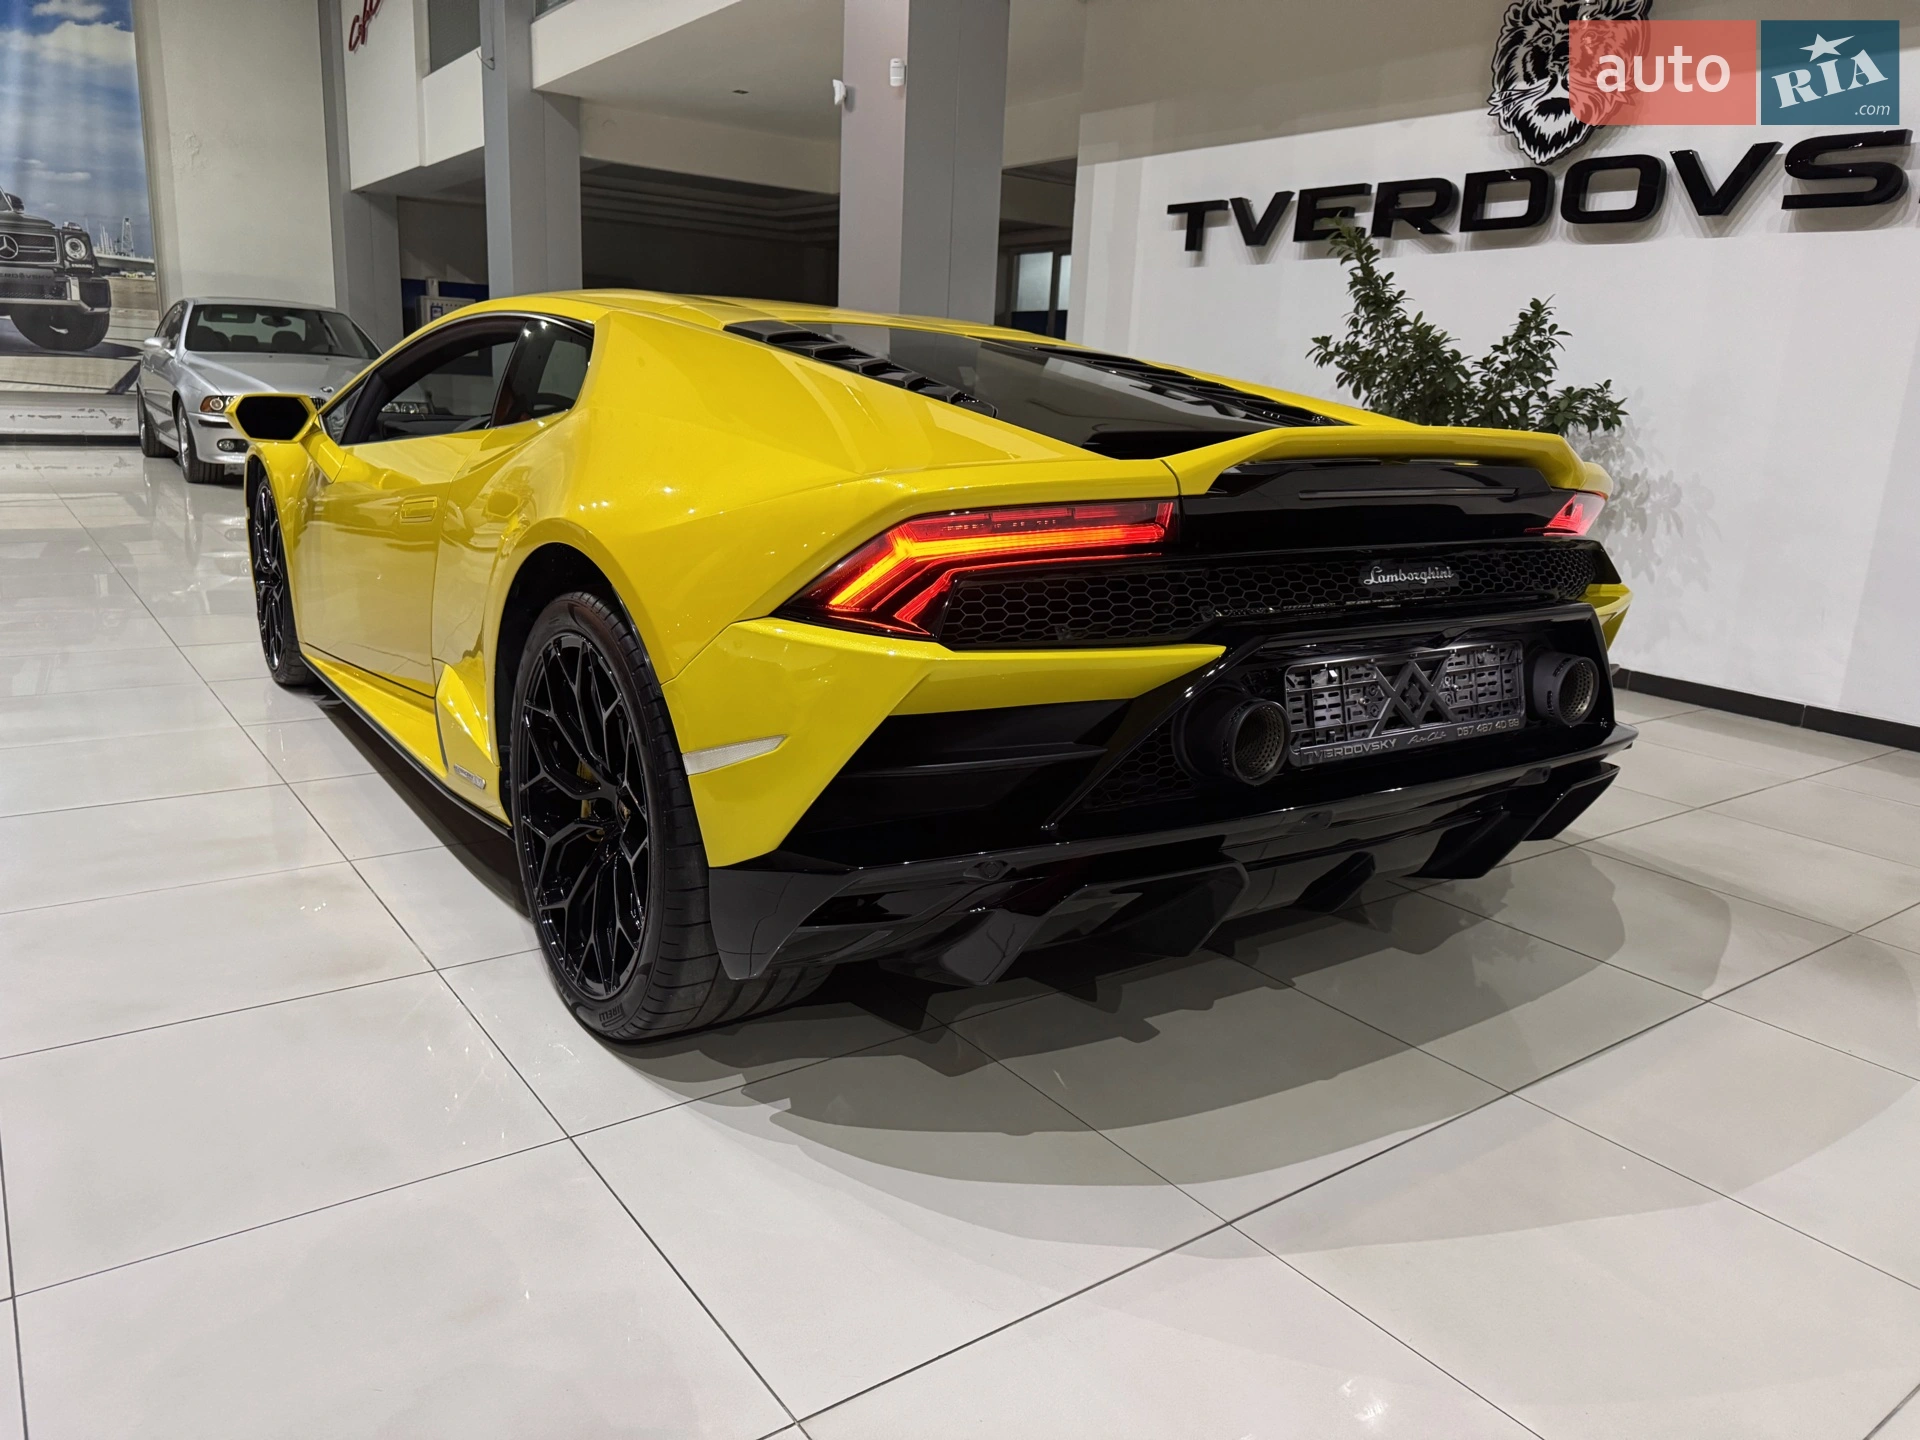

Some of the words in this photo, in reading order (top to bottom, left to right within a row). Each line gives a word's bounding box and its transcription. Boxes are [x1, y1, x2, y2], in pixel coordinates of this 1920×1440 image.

[1363, 566, 1454, 585] Lamborghini
[1303, 738, 1397, 765] TVERDOVSKY
[599, 1002, 626, 1028] PIRELLI
